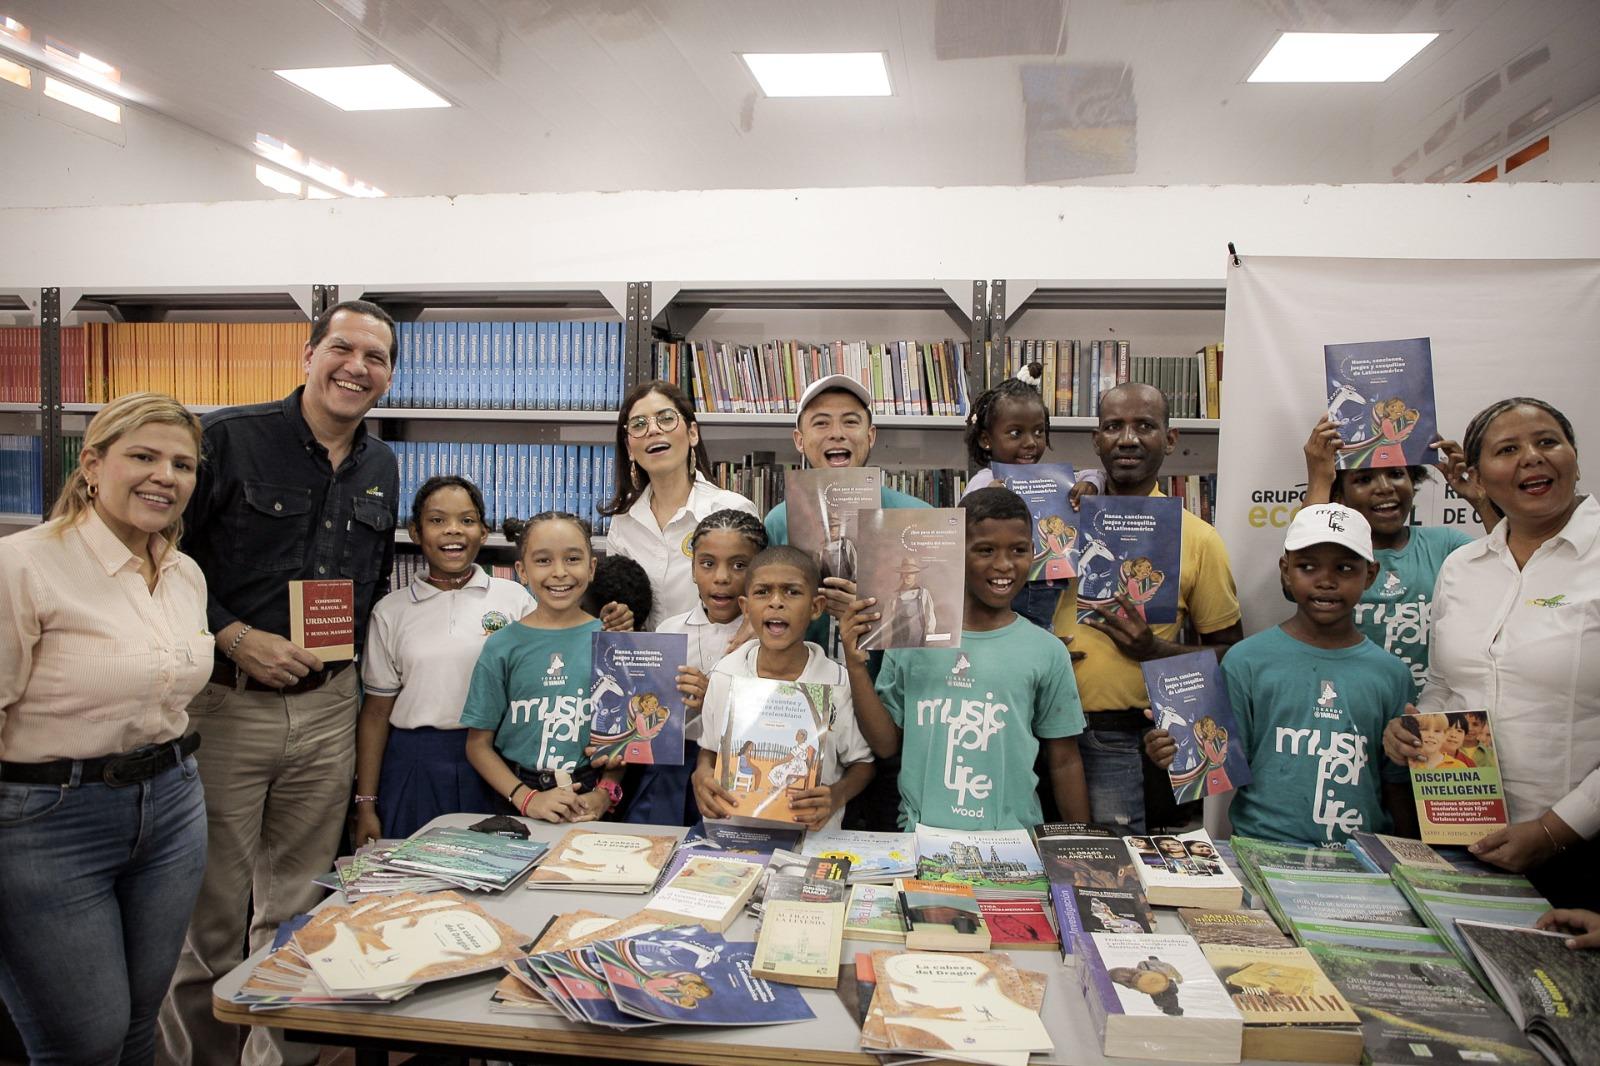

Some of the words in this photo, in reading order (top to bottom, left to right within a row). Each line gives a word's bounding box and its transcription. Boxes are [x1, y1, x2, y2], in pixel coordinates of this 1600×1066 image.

[1444, 508, 1466, 524] DE
[917, 692, 1009, 729] music
[1415, 771, 1480, 783] DISCIPLINA
[1421, 784, 1497, 795] INTELIGENTE
